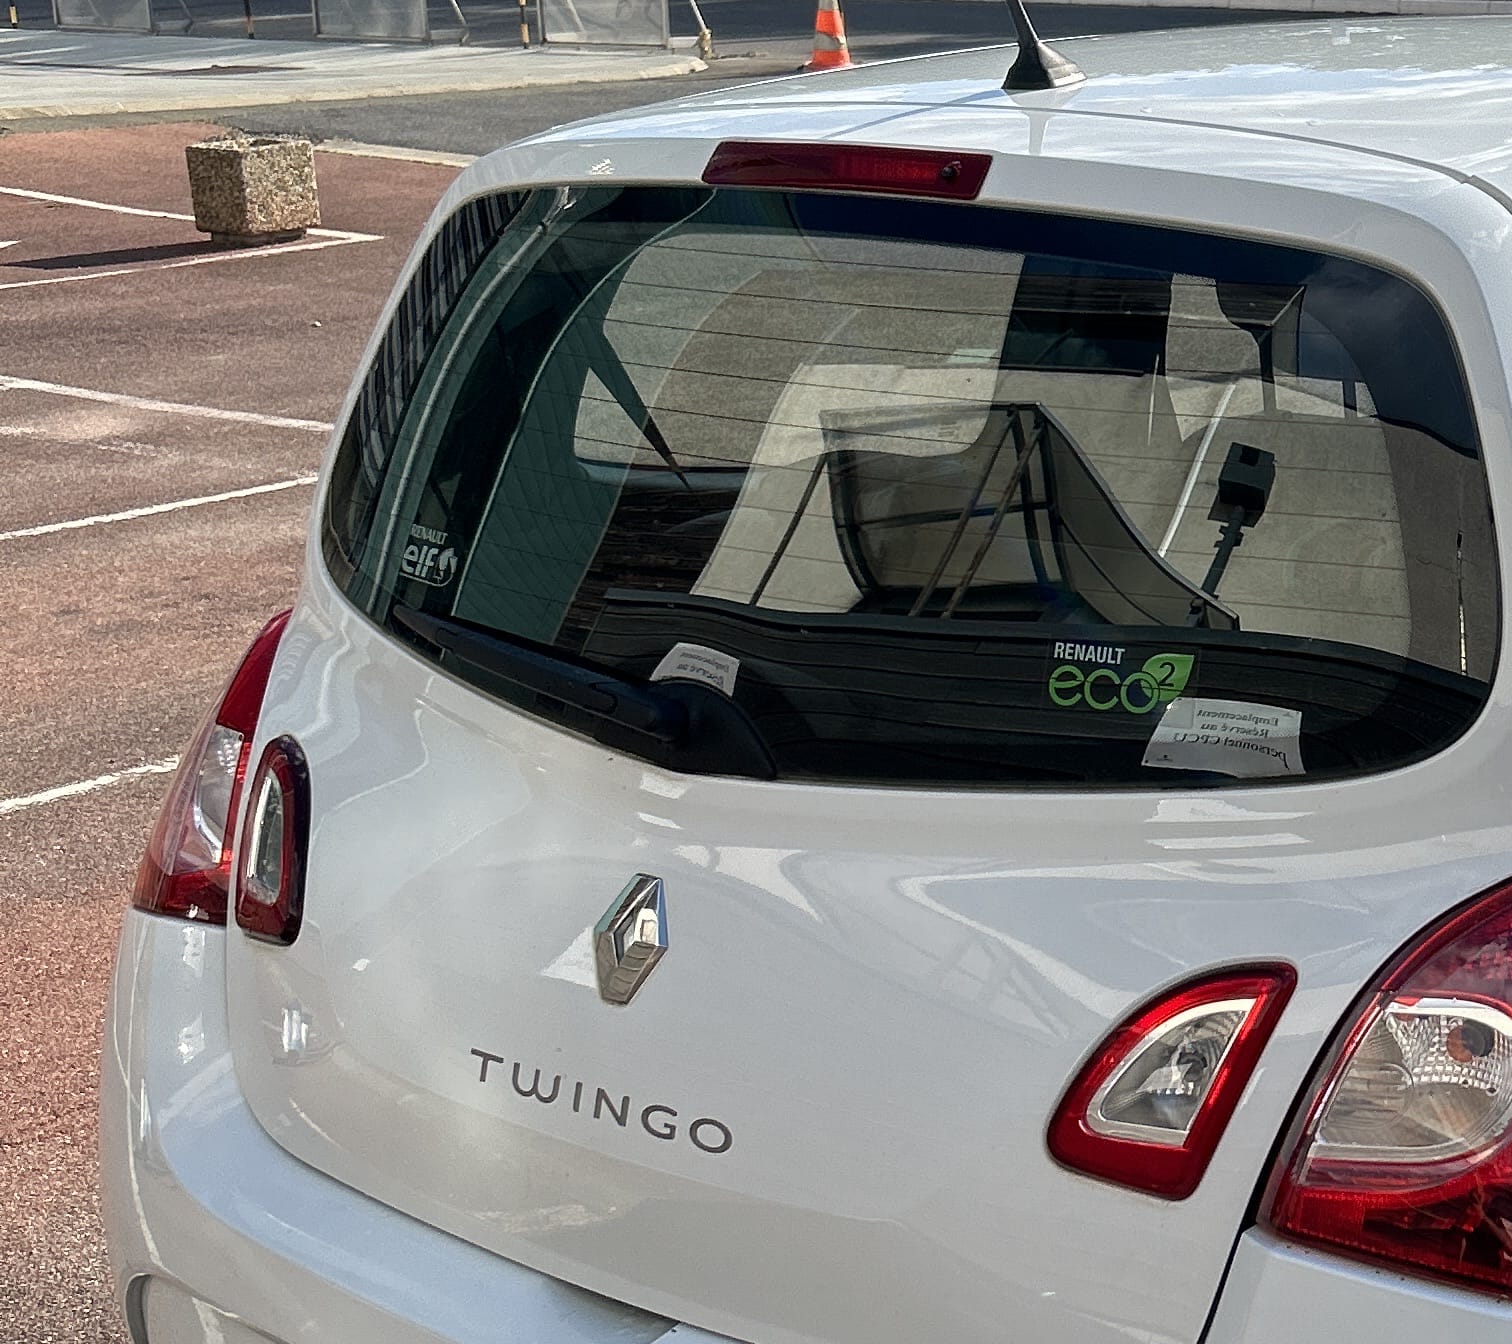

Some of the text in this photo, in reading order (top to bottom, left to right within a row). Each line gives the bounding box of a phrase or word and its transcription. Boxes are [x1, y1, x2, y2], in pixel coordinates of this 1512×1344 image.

[411, 524, 449, 544] RENAULT
[402, 544, 438, 577] elf
[1053, 642, 1126, 665] RENAULT
[470, 1047, 734, 1155] TWINGO
